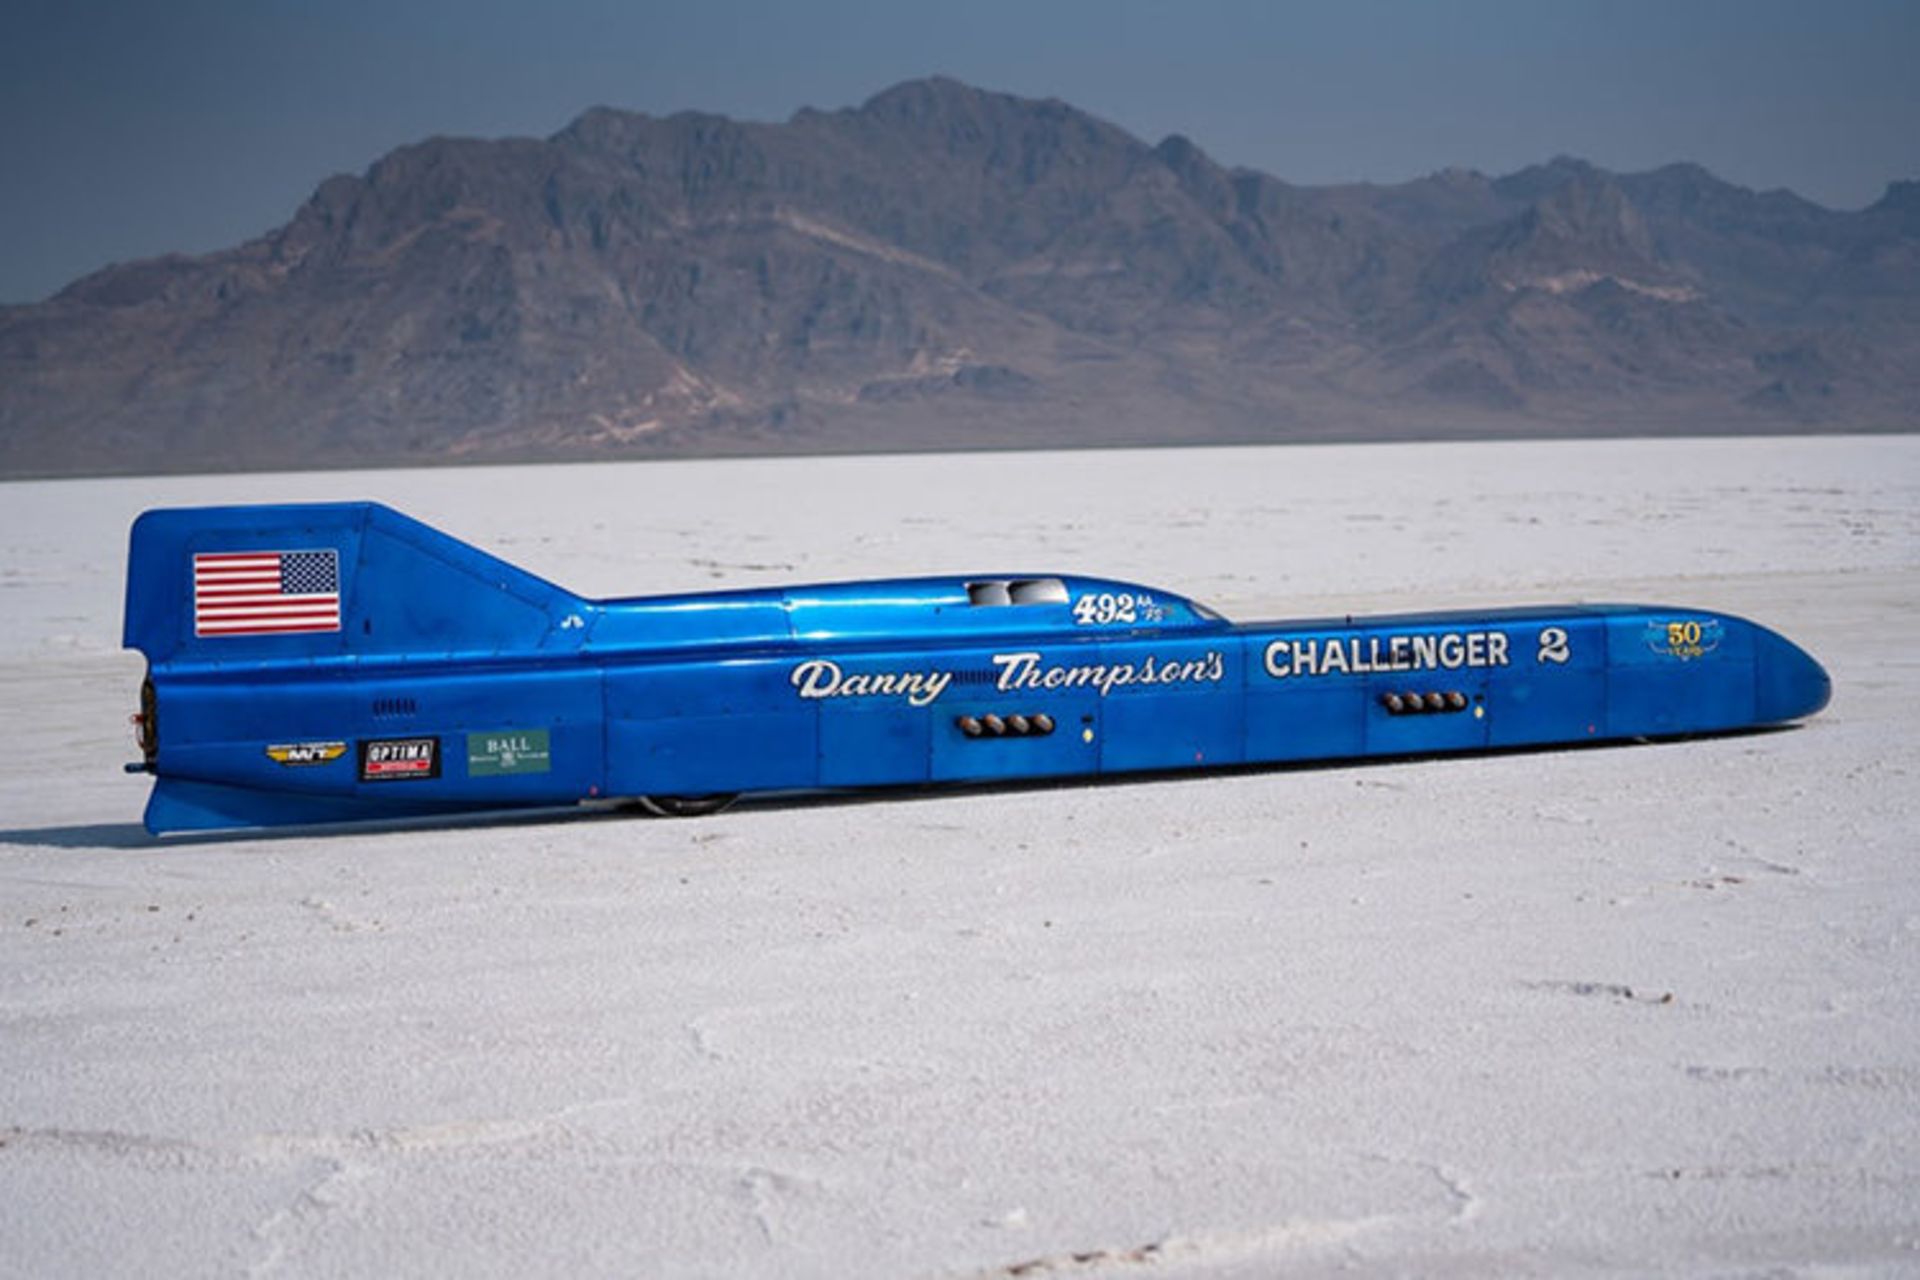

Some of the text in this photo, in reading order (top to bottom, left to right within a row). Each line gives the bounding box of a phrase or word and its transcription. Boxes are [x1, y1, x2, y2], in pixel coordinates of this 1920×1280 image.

[1073, 593, 1137, 624] 492
[1667, 622, 1701, 645] 50
[1264, 627, 1571, 677] CHALLENGER 2
[790, 651, 1223, 706] Danny Thompson's
[369, 744, 429, 762] OPTIMA
[487, 737, 531, 753] BALL
